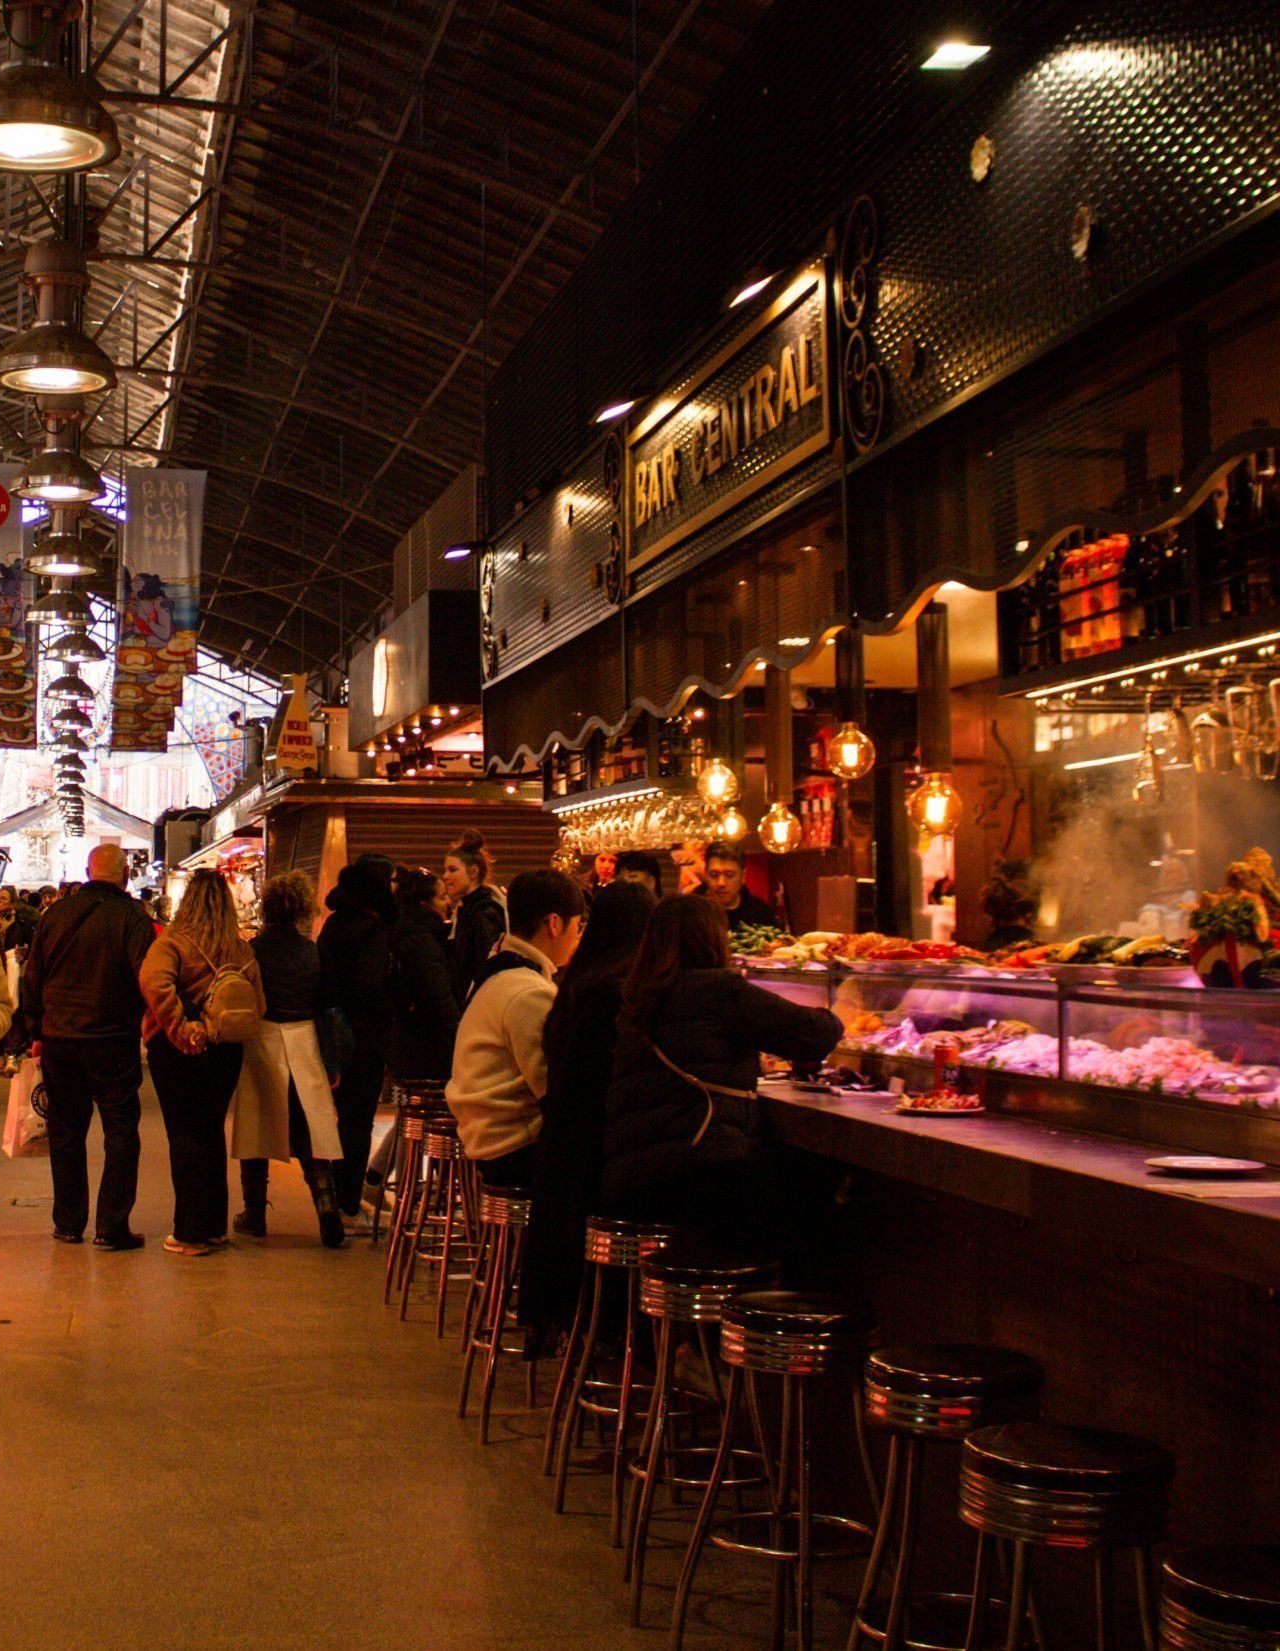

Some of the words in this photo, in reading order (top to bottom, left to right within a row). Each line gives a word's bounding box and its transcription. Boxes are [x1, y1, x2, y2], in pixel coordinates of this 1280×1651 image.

[634, 442, 678, 528] BAR
[690, 333, 821, 486] CENTRAL
[141, 479, 188, 498] BAR
